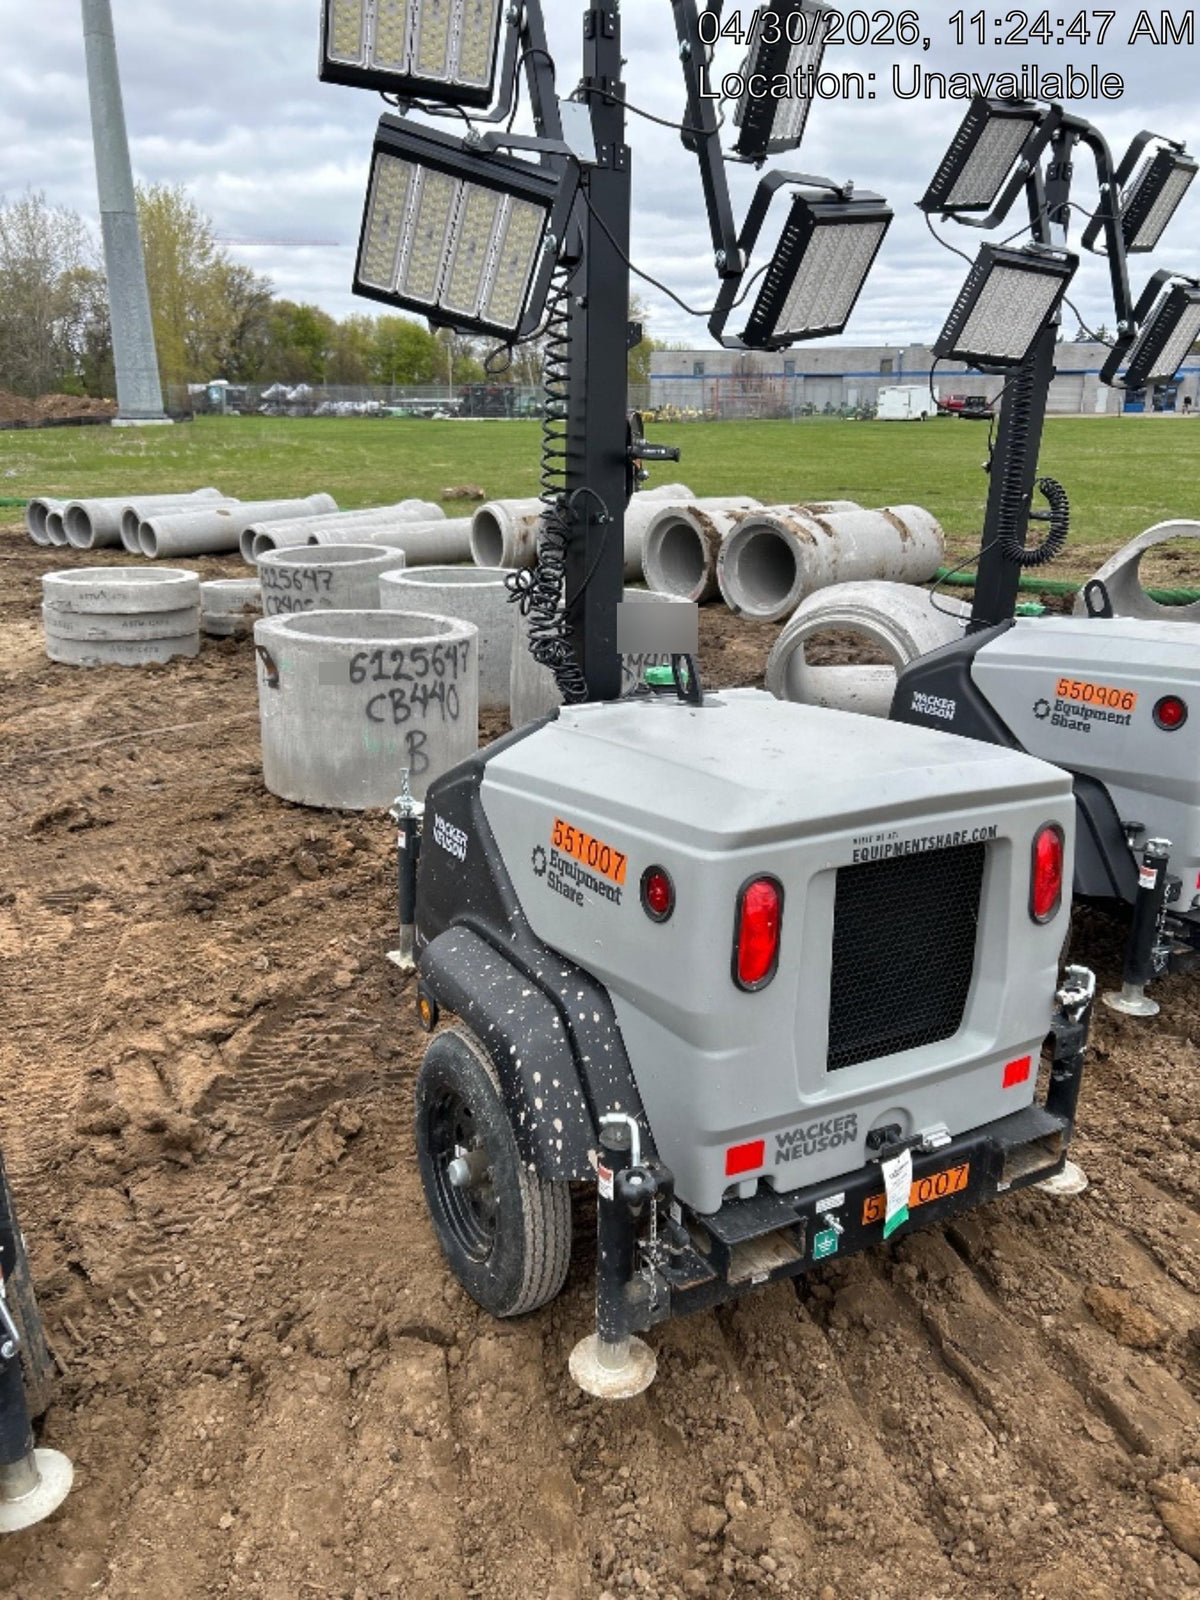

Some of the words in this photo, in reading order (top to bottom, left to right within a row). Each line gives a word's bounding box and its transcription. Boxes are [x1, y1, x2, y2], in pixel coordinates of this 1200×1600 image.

[349, 639, 470, 685] 6125647
[365, 680, 460, 725] CB440
[1053, 698, 1132, 726] Equipment
[1057, 678, 1135, 711] 550906
[1050, 714, 1092, 734] Share
[404, 730, 429, 776] B
[552, 818, 626, 881] 551007
[852, 824, 999, 863] EQUIPMENTSHARE.COM
[546, 870, 585, 908] Share
[548, 847, 624, 906] Equipment
[774, 1112, 858, 1149] WACKER
[774, 1127, 858, 1165] NEUSON
[866, 1164, 967, 1222] 5007
